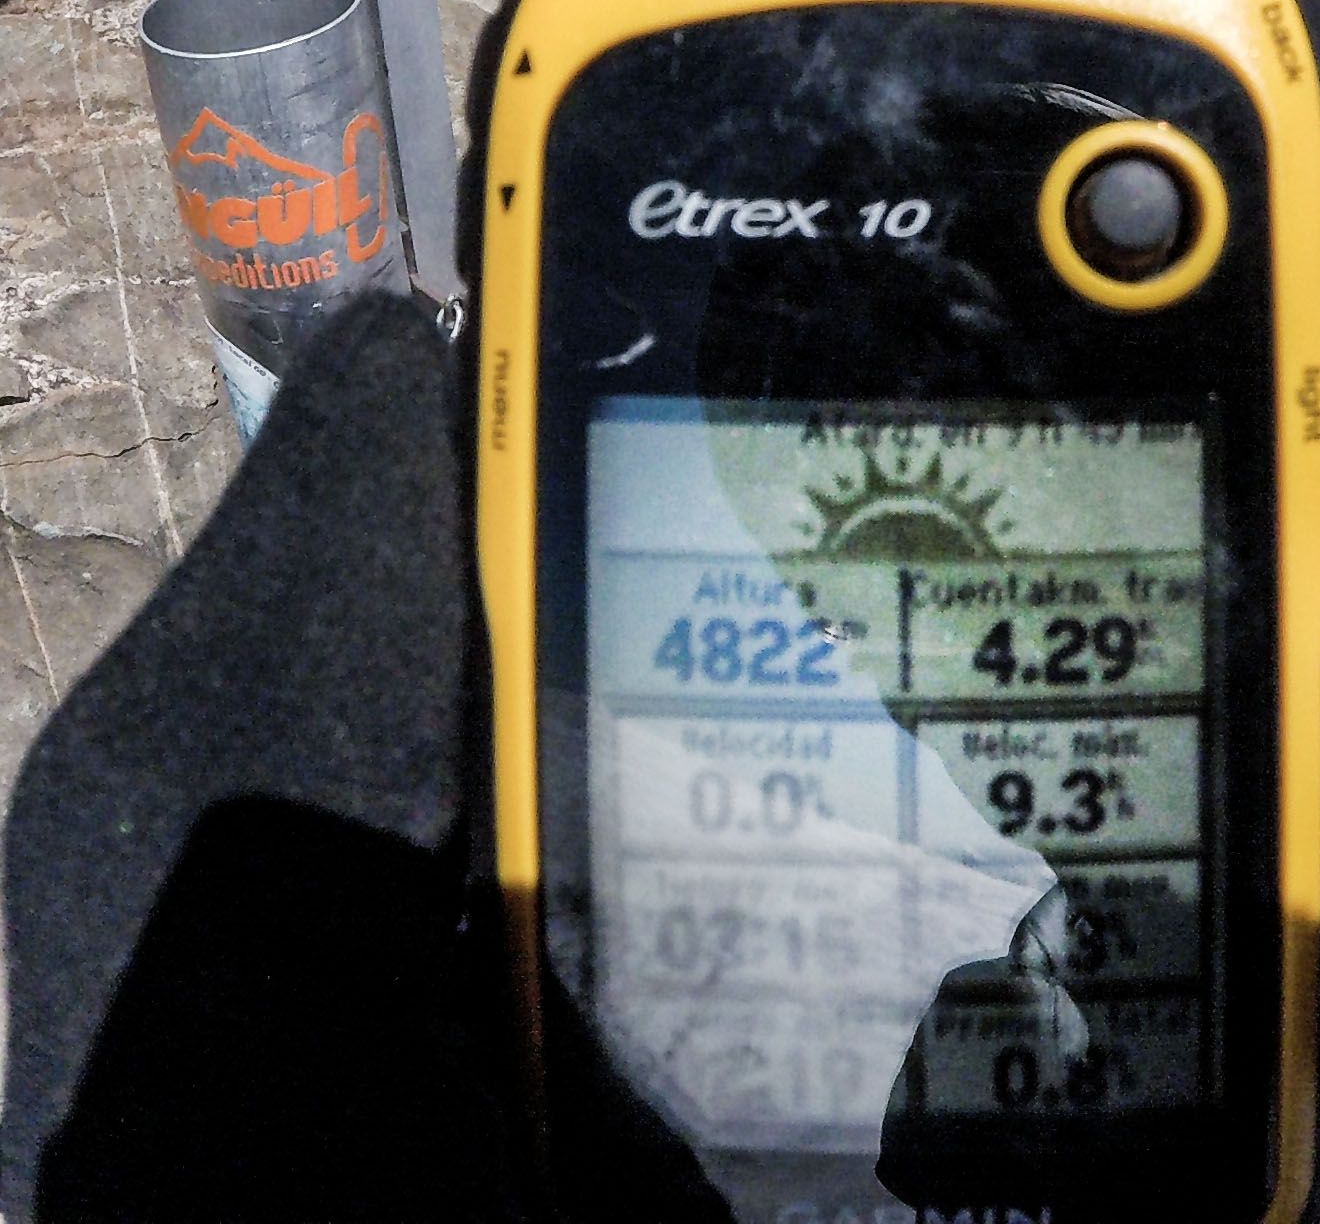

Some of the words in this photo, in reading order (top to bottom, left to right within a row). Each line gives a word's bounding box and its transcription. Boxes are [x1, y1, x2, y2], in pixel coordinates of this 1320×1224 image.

[1260, 2, 1305, 85] back
[858, 198, 932, 241] 10
[652, 616, 841, 687] 4822
[973, 616, 1138, 688] 4.29
[690, 769, 806, 837] 0.0
[988, 767, 1109, 838] 9.3
